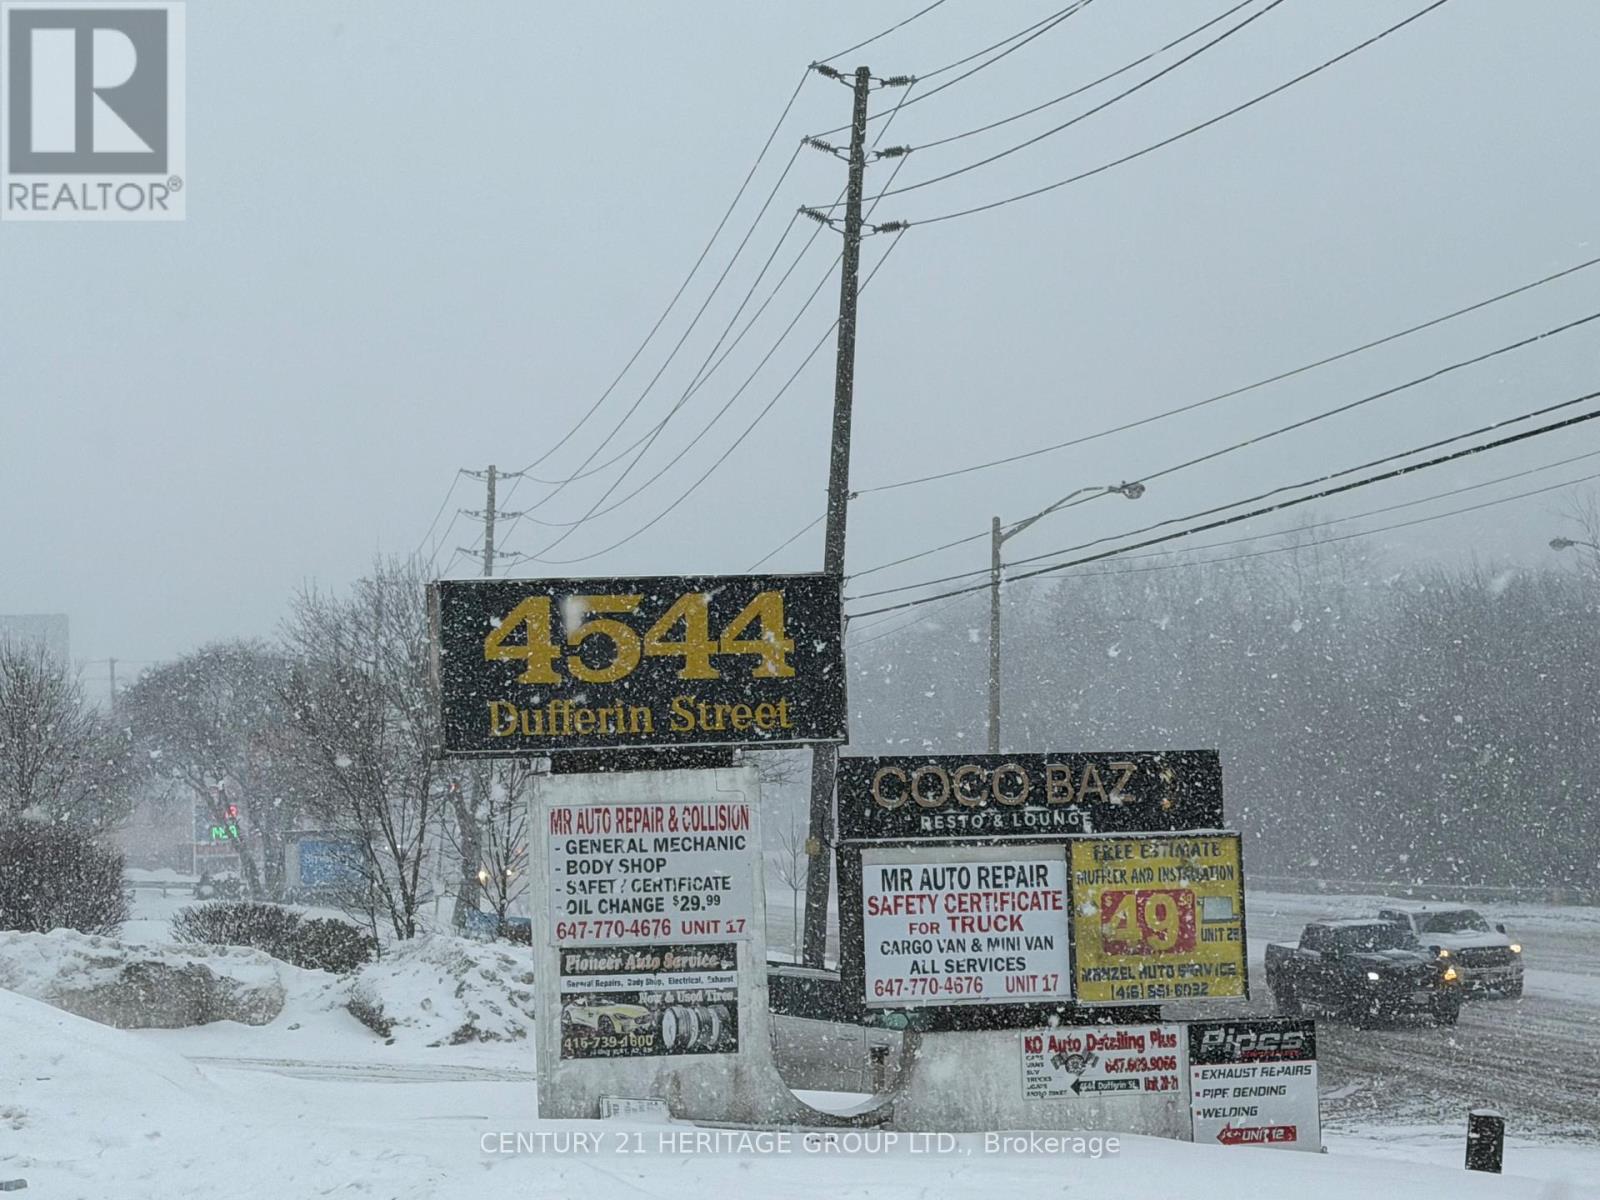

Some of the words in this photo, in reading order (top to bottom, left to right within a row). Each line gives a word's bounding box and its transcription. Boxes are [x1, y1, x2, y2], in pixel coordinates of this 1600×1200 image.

[484, 590, 796, 684] 4544
[489, 699, 654, 737] Dufferin
[671, 696, 794, 732] Street
[872, 763, 1030, 808] COCO
[1047, 762, 1137, 804] BAZ
[550, 808, 572, 835] MR
[576, 807, 611, 834] AUTO
[616, 806, 664, 833] REPAIR
[668, 806, 679, 832] &
[683, 804, 749, 832] COLLISION
[920, 814, 983, 830] RESTO
[993, 813, 1003, 828] &
[1013, 811, 1092, 829] LOUNGE
[565, 838, 649, 855] GENERAL
[653, 835, 746, 853] MECHANIC
[1093, 844, 1134, 860] FREE
[1140, 841, 1221, 859] ESTIMATE
[566, 859, 614, 875] BODY
[618, 858, 667, 874] SHOP
[631, 875, 731, 893] CERTIFICATE
[881, 868, 912, 892] MR
[920, 866, 970, 891] AUTO
[978, 864, 1048, 889] REPAIR
[1077, 869, 1127, 886] MUFFLER
[1132, 868, 1154, 884] AND
[566, 899, 593, 915] OIL
[599, 897, 664, 914] CHANGE
[672, 895, 721, 912] $29.99
[868, 893, 938, 916] SAFETY
[944, 890, 1063, 914] CERTIFICATE
[556, 918, 671, 940] 647-770-4676
[681, 919, 720, 935] UNIT
[725, 918, 746, 933] 17
[909, 922, 940, 935] FOR
[947, 914, 1024, 933] TRUCK
[1201, 927, 1225, 941] UNIT
[881, 940, 932, 955] CARGO
[937, 938, 965, 954] VAN
[971, 938, 982, 953] &
[987, 937, 1020, 952] MINI
[1025, 936, 1054, 951] VAN
[565, 954, 622, 973] Pioneer
[624, 953, 660, 971] Auto
[663, 951, 720, 969] Service
[910, 960, 940, 975] ALL
[944, 957, 1026, 974] SERVICES
[1139, 963, 1174, 980] AUTO
[1178, 962, 1236, 978] SERVICE
[875, 976, 983, 996] 647-770-4676
[1005, 975, 1038, 992] UNIT
[1042, 974, 1058, 992] 17
[1048, 1034, 1081, 1053] Auto
[1086, 1031, 1145, 1053] Detailing
[1149, 1029, 1177, 1049] Plus
[1201, 1066, 1258, 1080] EXHAUST
[1260, 1064, 1313, 1077] REPAIRS
[1202, 1088, 1230, 1099] PIPE
[1233, 1085, 1287, 1098] BENDING
[1202, 1106, 1258, 1119] WELDING
[1242, 1129, 1270, 1141] UNIT
